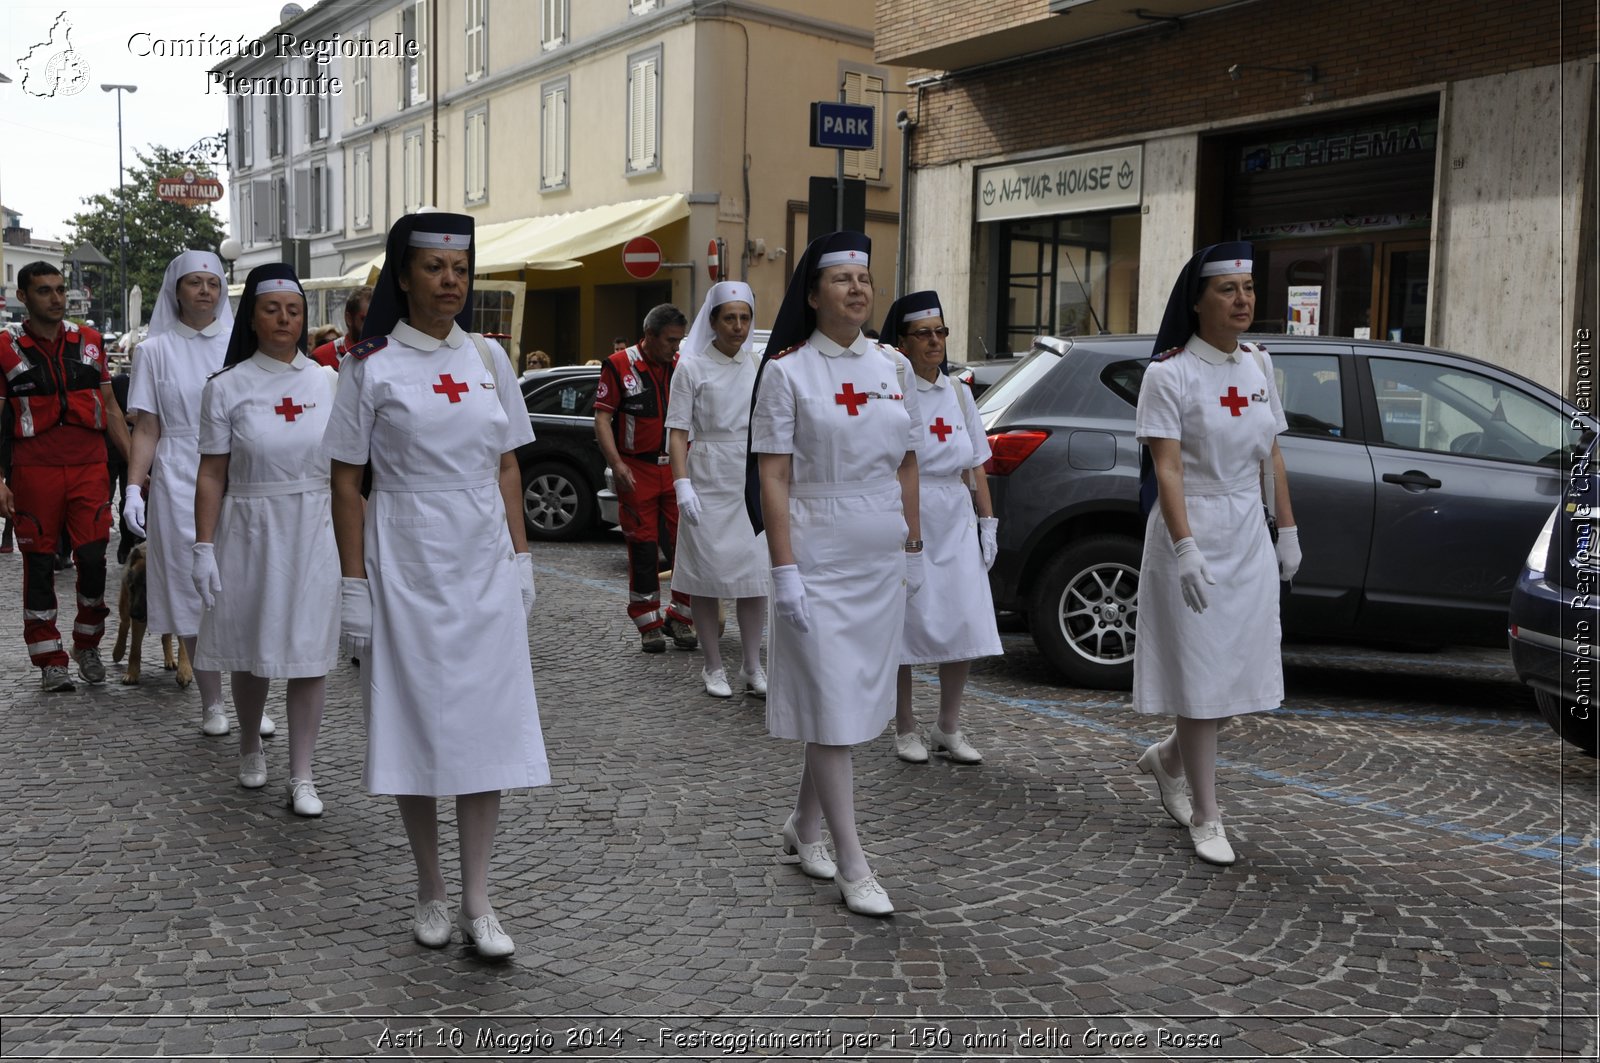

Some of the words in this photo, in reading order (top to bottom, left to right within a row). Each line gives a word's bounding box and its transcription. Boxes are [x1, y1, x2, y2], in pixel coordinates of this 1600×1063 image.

[823, 115, 869, 136] PARK
[158, 183, 189, 197] CAFFE'
[189, 185, 219, 198] ITALIA
[999, 174, 1053, 203] NATUR
[1056, 165, 1113, 196] HOUSE
